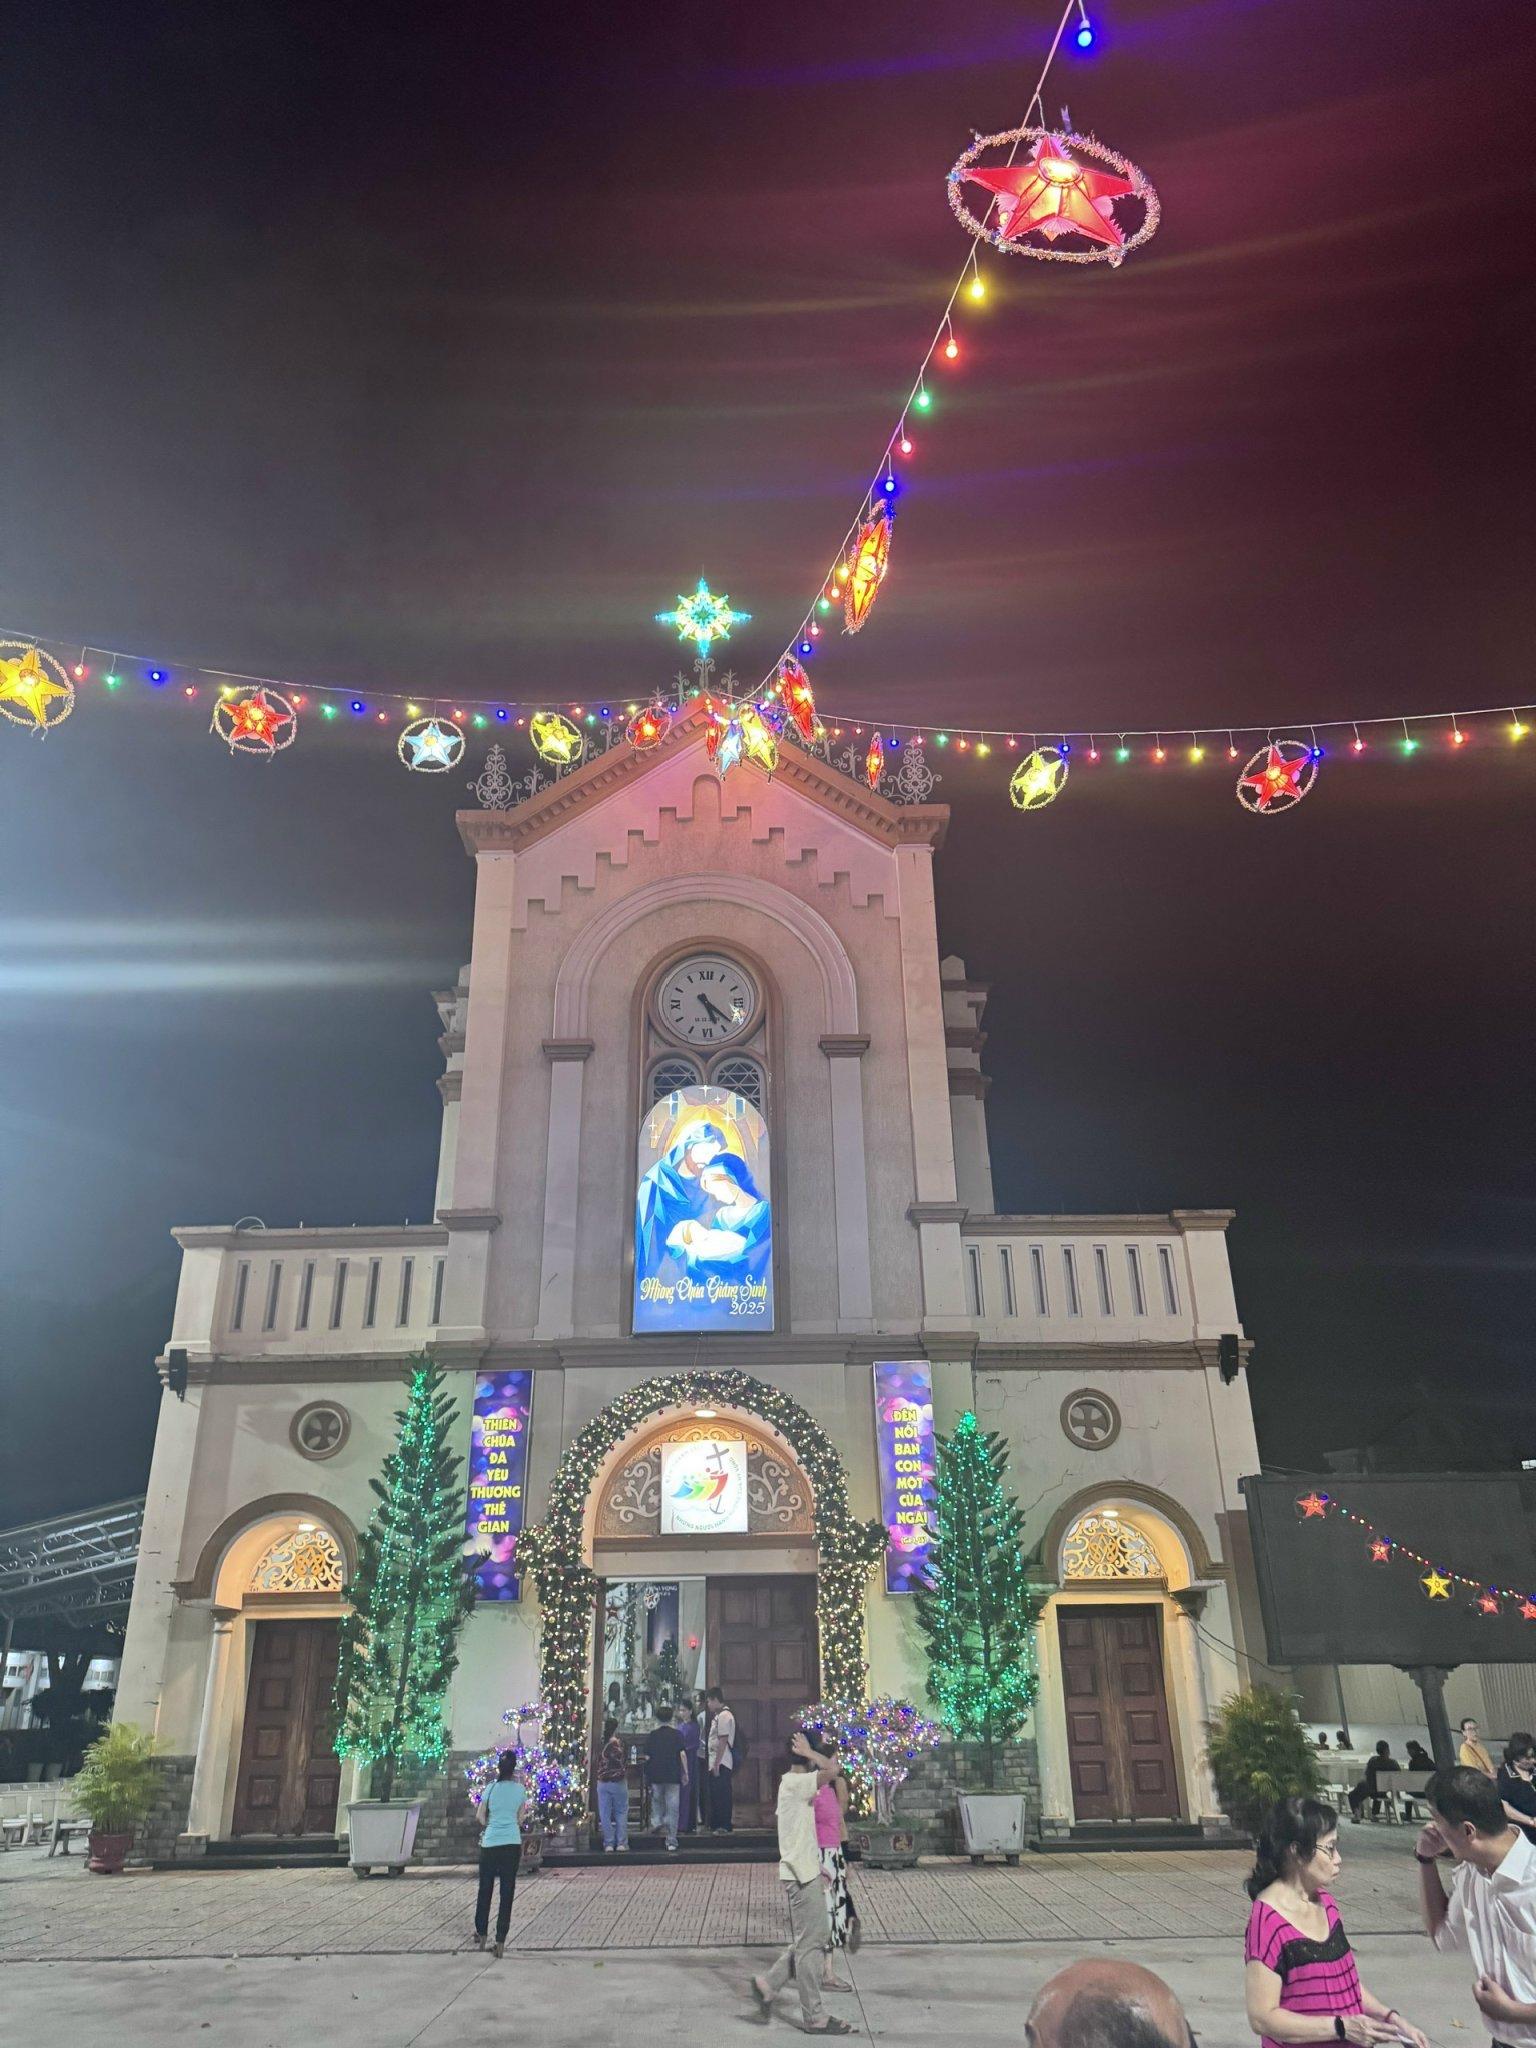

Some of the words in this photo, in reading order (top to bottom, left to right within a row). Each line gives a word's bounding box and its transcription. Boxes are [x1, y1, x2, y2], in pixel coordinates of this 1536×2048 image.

[699, 971, 714, 981] XII
[702, 1028, 713, 1038] VI
[676, 1276, 705, 1303] Chúa
[706, 1275, 739, 1304] Giáng
[740, 1274, 767, 1301] Sinh
[729, 1302, 766, 1315] 2025
[484, 1418, 517, 1431] THIÊN
[894, 1443, 920, 1455] BAN
[895, 1459, 922, 1472] CON
[486, 1468, 509, 1481] YÊU
[896, 1476, 923, 1490] MỘT
[477, 1520, 509, 1533] GIAN
